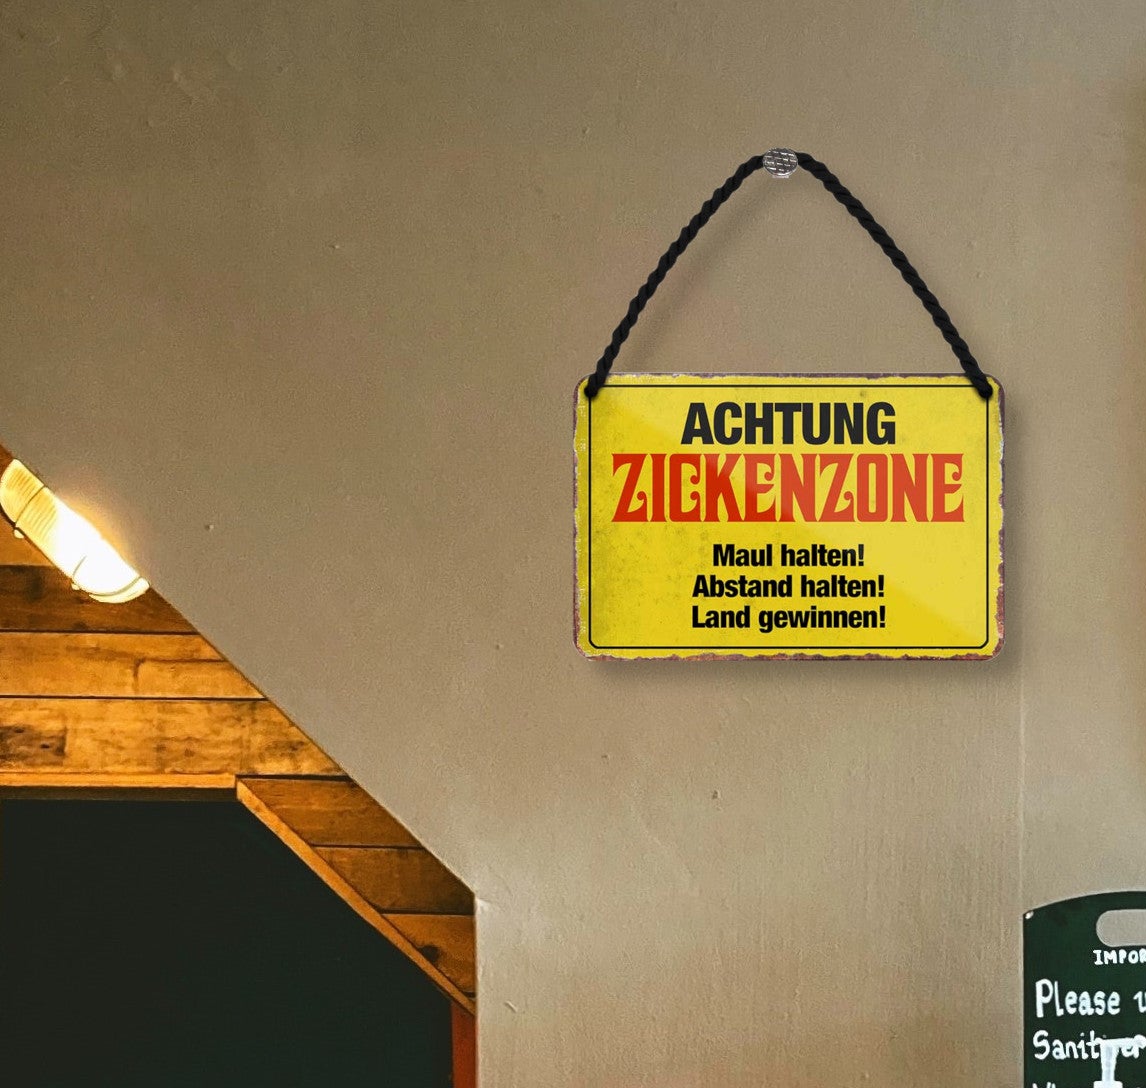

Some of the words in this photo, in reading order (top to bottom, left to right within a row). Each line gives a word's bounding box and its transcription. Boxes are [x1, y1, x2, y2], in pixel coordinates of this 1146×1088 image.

[681, 401, 896, 446] ACHTUNG
[611, 453, 965, 523] ZICKENZONE
[712, 543, 773, 567] Maul
[780, 543, 865, 567] halten!
[692, 574, 793, 598] Abstand
[800, 574, 885, 598] halten!
[692, 605, 751, 629] Land
[758, 605, 886, 634] gewinnen!
[1035, 978, 1121, 1018] Please
